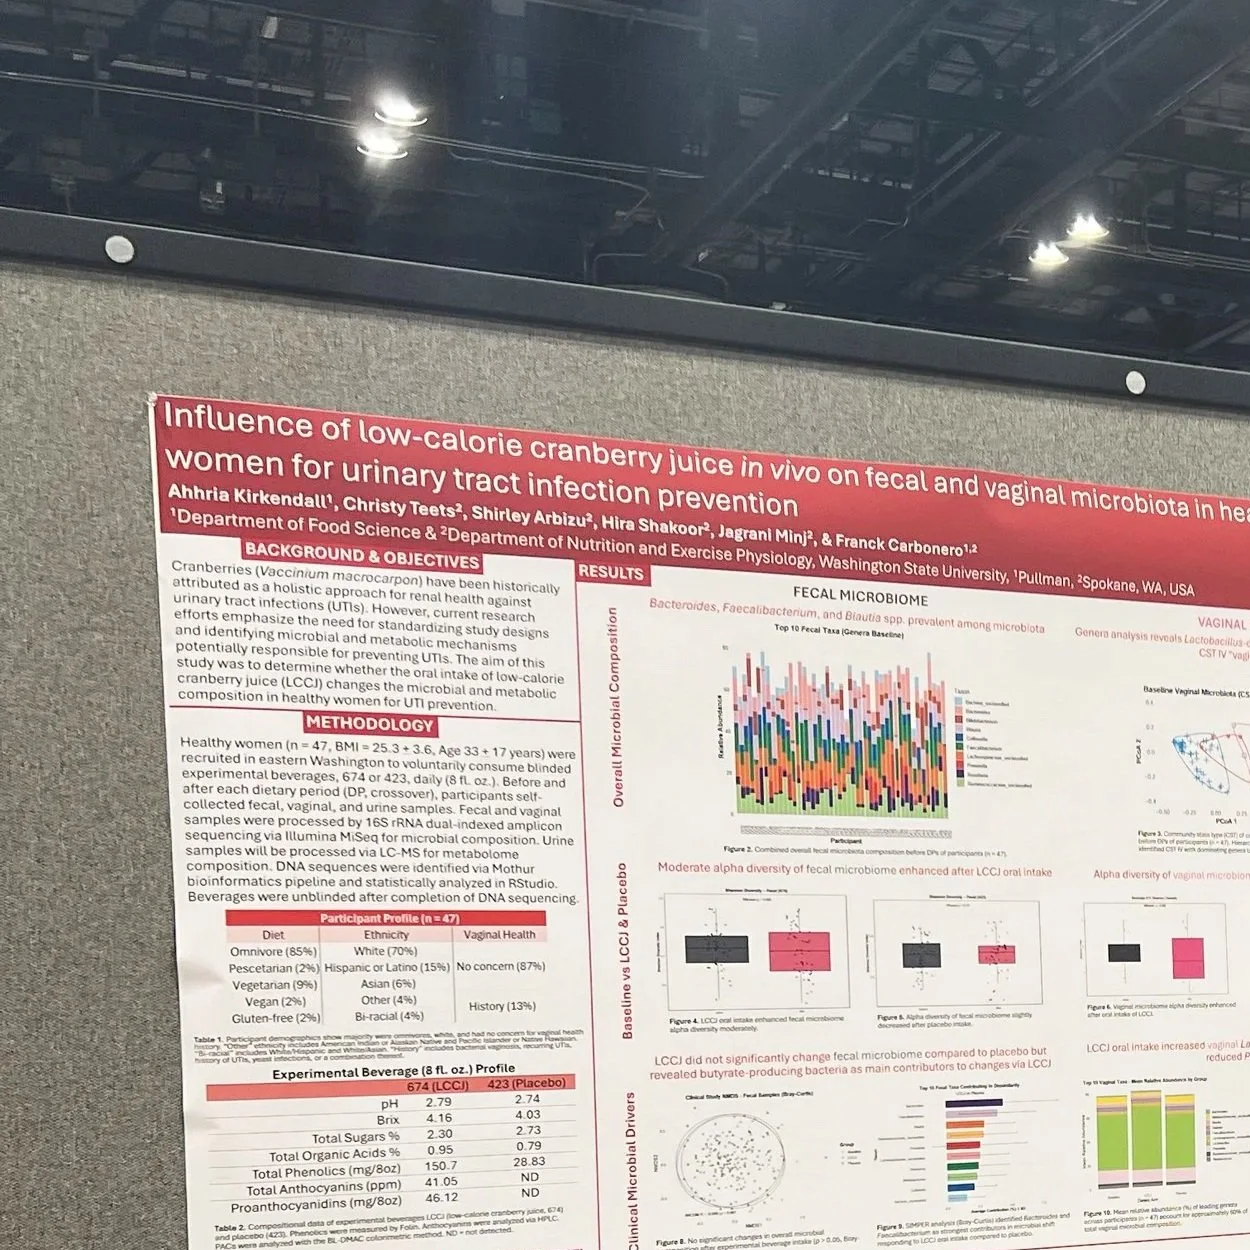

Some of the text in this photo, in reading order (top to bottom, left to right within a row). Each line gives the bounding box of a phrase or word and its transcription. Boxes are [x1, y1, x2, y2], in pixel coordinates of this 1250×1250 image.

[164, 400, 313, 438] Influence
[321, 417, 351, 441] of
[358, 418, 522, 456] low-calorie
[529, 440, 663, 474] cranberry
[668, 448, 733, 476] juice
[740, 454, 763, 478] in
[769, 458, 820, 483] vivo
[827, 467, 859, 486] on
[864, 465, 928, 491] fecal
[933, 473, 978, 496] and
[983, 479, 1066, 506] vaginal
[1070, 487, 1189, 517] microbiota
[1193, 497, 1214, 520] in
[164, 448, 798, 517] women for urinary tract infection prevention
[167, 482, 229, 502] Ahhria
[342, 495, 406, 517] Christy
[471, 504, 531, 526] Shirley
[601, 514, 635, 531] Hira
[717, 523, 772, 542] Jagrani
[820, 532, 832, 546] &
[835, 533, 885, 550] Franck
[244, 541, 480, 569] BACKGROUND & OBJECTIVES
[286, 516, 304, 531] of
[308, 516, 350, 534] Food
[353, 520, 421, 539] Science
[424, 525, 437, 540] &
[546, 534, 563, 548] of
[566, 534, 635, 554] Nutrition
[638, 542, 667, 556] and
[670, 542, 732, 561] Exercise
[735, 547, 815, 570] Physiology,
[817, 553, 901, 575] Washington
[903, 560, 939, 577] State
[941, 563, 1009, 584] University,
[1141, 579, 1166, 596] WA,
[1169, 582, 1195, 597] USA
[170, 559, 560, 596] Cranberries (Vaccinium macrocarpon) have been historically
[578, 563, 644, 580] RESULTS
[793, 585, 928, 606] FECAL MICROBIOME
[1197, 615, 1247, 630] VAGINAL
[606, 606, 624, 808] Overall Microbial Composition
[305, 714, 433, 732] METHODOLOGY
[657, 861, 1052, 877] Moderate alpha diversity of fecal microbiome enhanced after LCCJ oral intake
[319, 912, 381, 925] Participant
[382, 912, 419, 923] Profile
[420, 913, 432, 925] (n
[441, 913, 460, 925] 47)
[262, 929, 284, 940] Diet
[363, 929, 410, 942] Ethnicity
[462, 929, 536, 942] Vaginal Health
[352, 945, 418, 958] White (70%)
[615, 862, 633, 1039] Baseline vs LCCJ & Placebo
[376, 1114, 400, 1126] Brix
[425, 1112, 452, 1122] 4.16
[514, 1108, 541, 1120] 4.03
[624, 1091, 636, 1138] Drivers
[625, 1140, 638, 1201] Microbial
